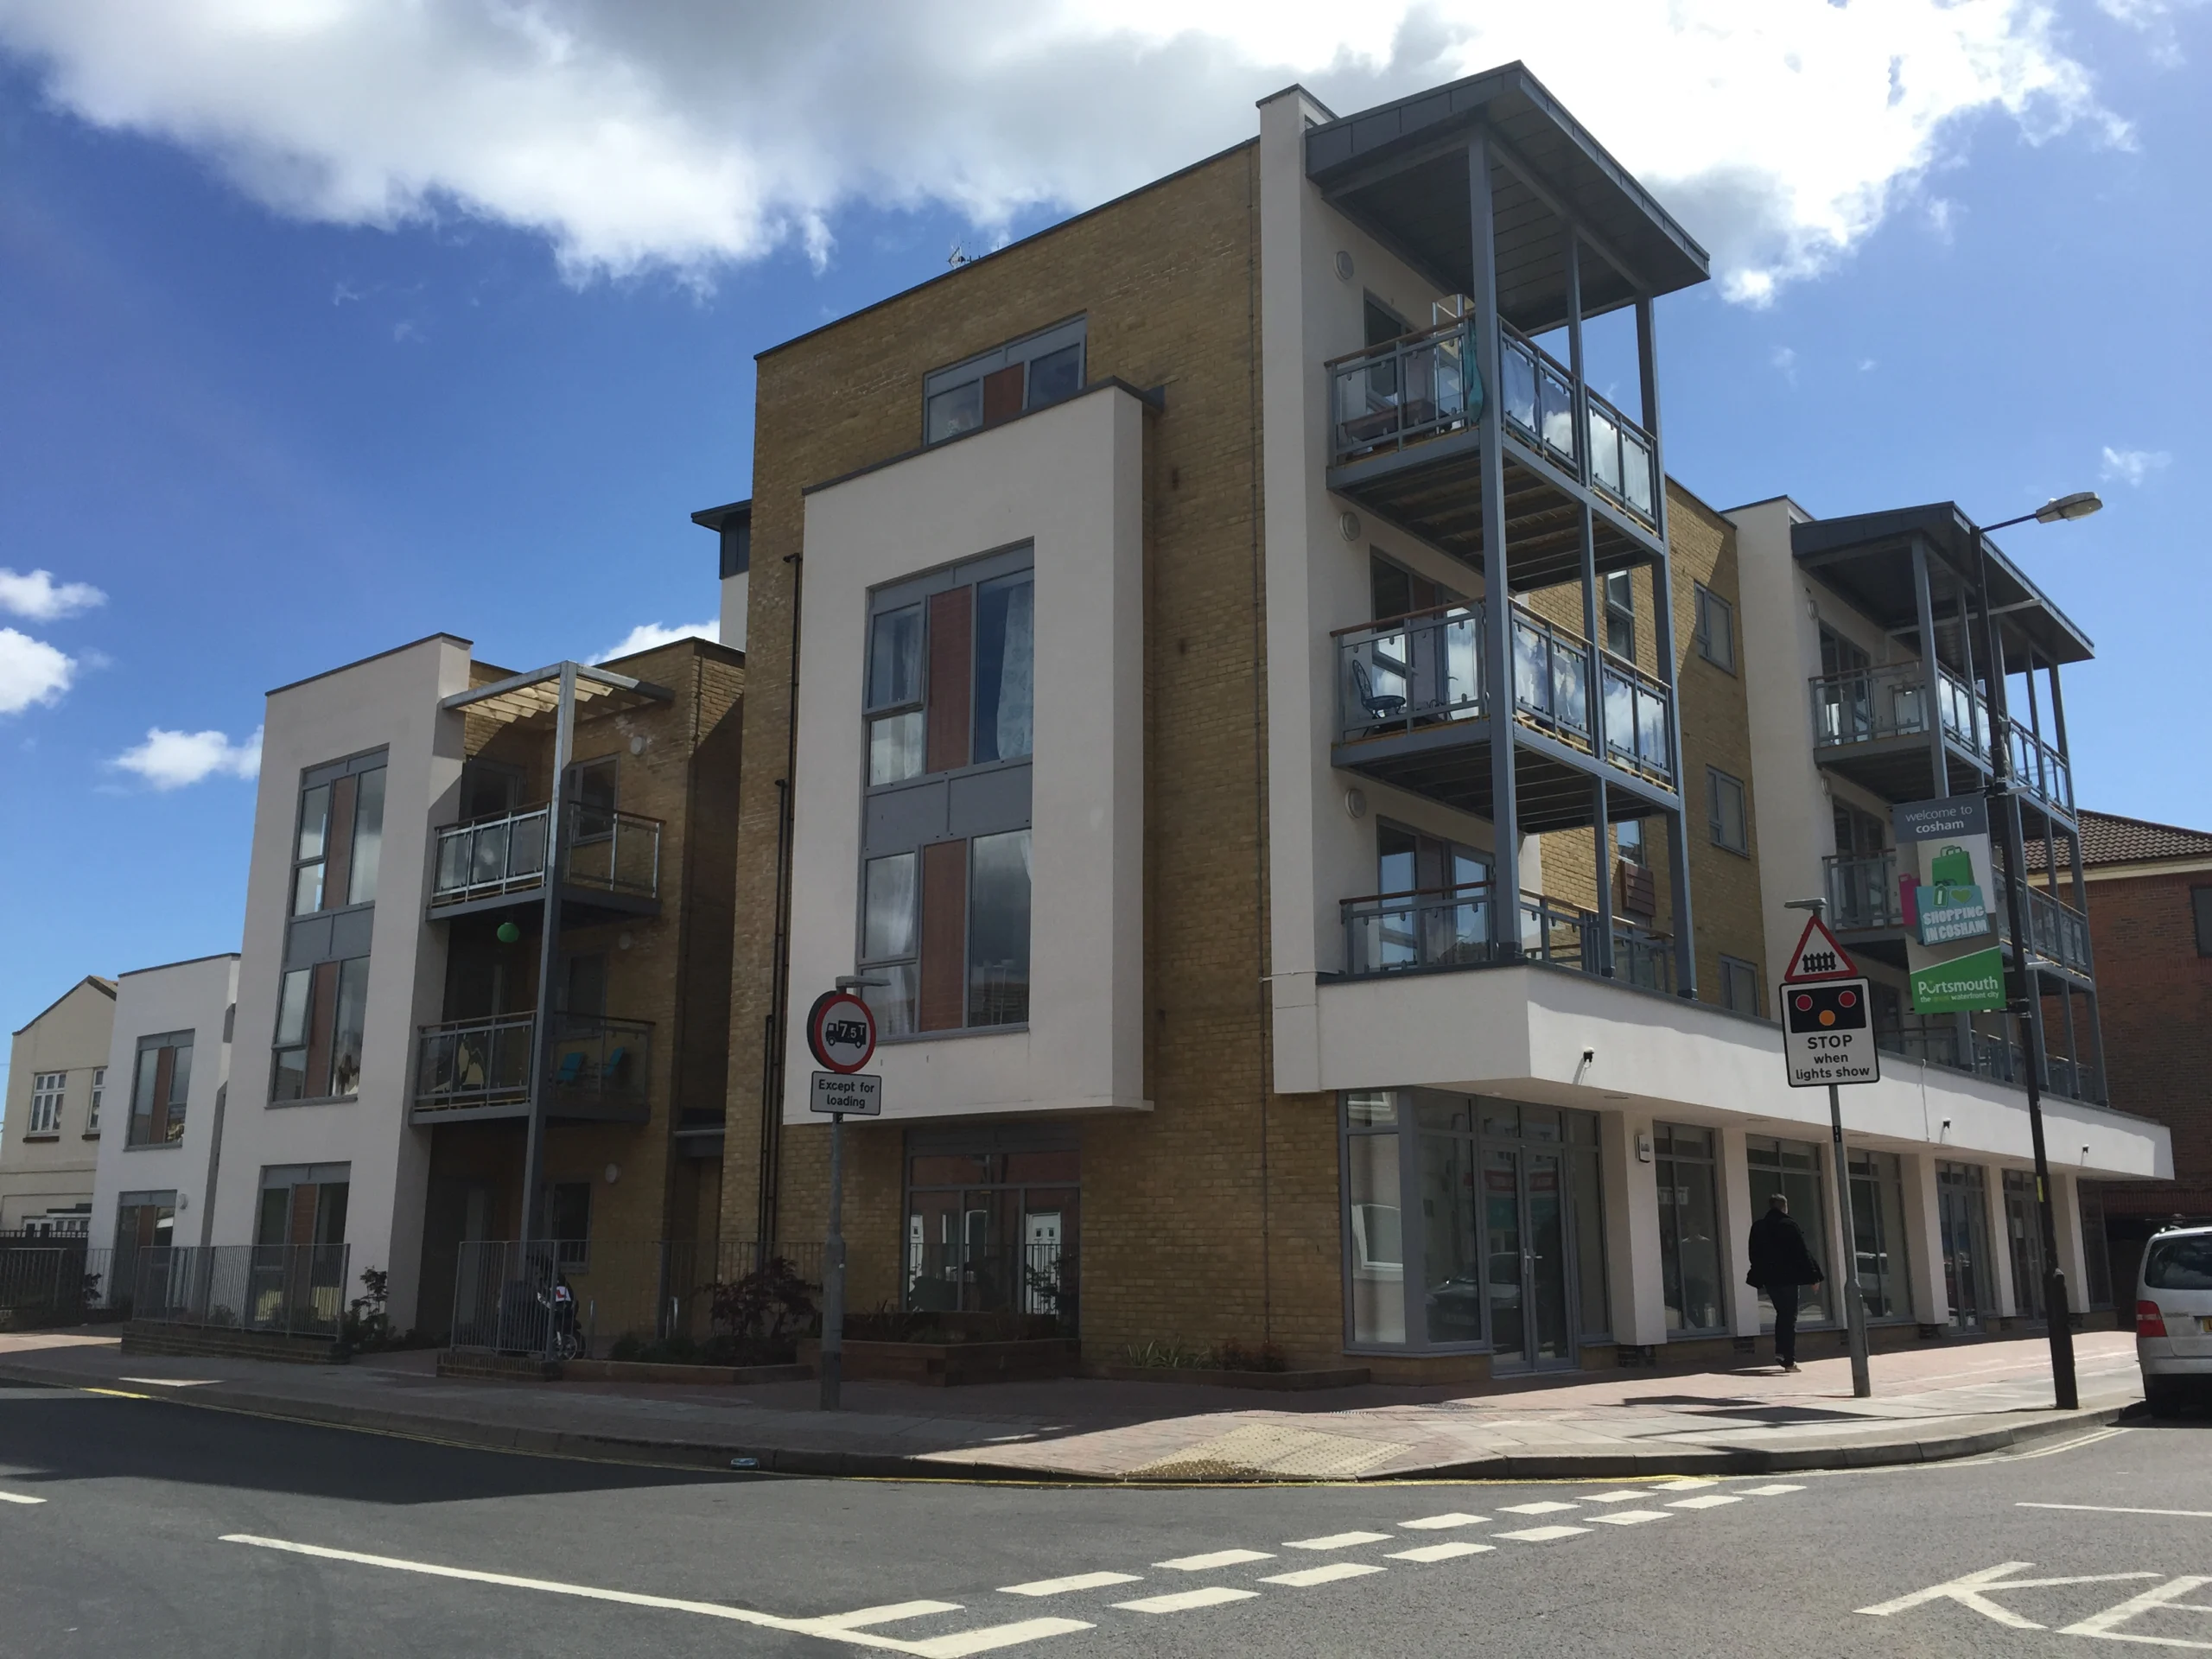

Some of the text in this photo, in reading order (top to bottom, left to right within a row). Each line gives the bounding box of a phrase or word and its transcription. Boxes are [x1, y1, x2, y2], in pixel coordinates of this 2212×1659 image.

[1905, 805, 1973, 822] welcome to
[1916, 820, 1964, 834] cosham
[1937, 890, 1943, 905] I
[1923, 906, 1984, 925] SHOPPING
[1925, 919, 1987, 942] IN COSHAM
[1918, 976, 1999, 995] Portsmouth
[1950, 992, 1986, 1001] waterfront
[1987, 990, 1999, 999] city
[1808, 1034, 1853, 1050] STOP
[1814, 1053, 1848, 1064] when
[1796, 1066, 1870, 1081] lights show
[818, 1079, 874, 1094] Except for
[827, 1094, 866, 1109] loading
